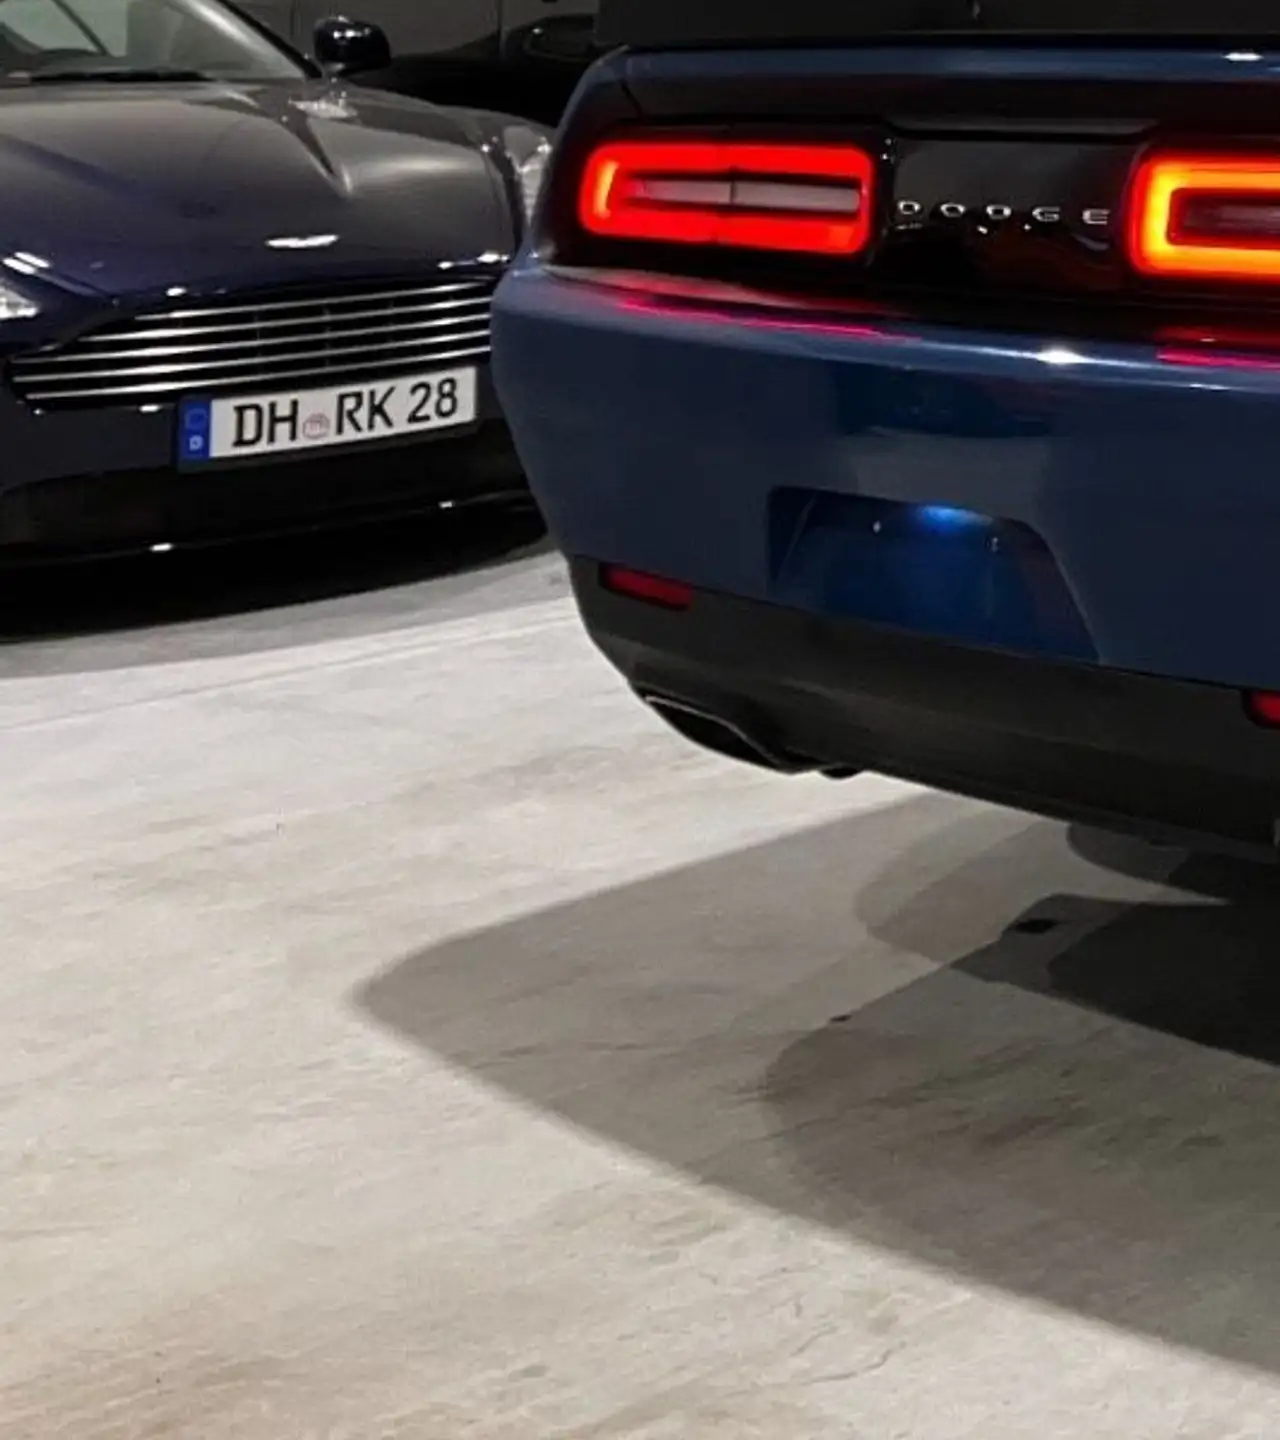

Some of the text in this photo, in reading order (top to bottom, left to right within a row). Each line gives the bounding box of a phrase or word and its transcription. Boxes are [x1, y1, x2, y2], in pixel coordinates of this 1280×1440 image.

[897, 200, 1111, 225] DODGE
[232, 377, 459, 448] DH RK 28
